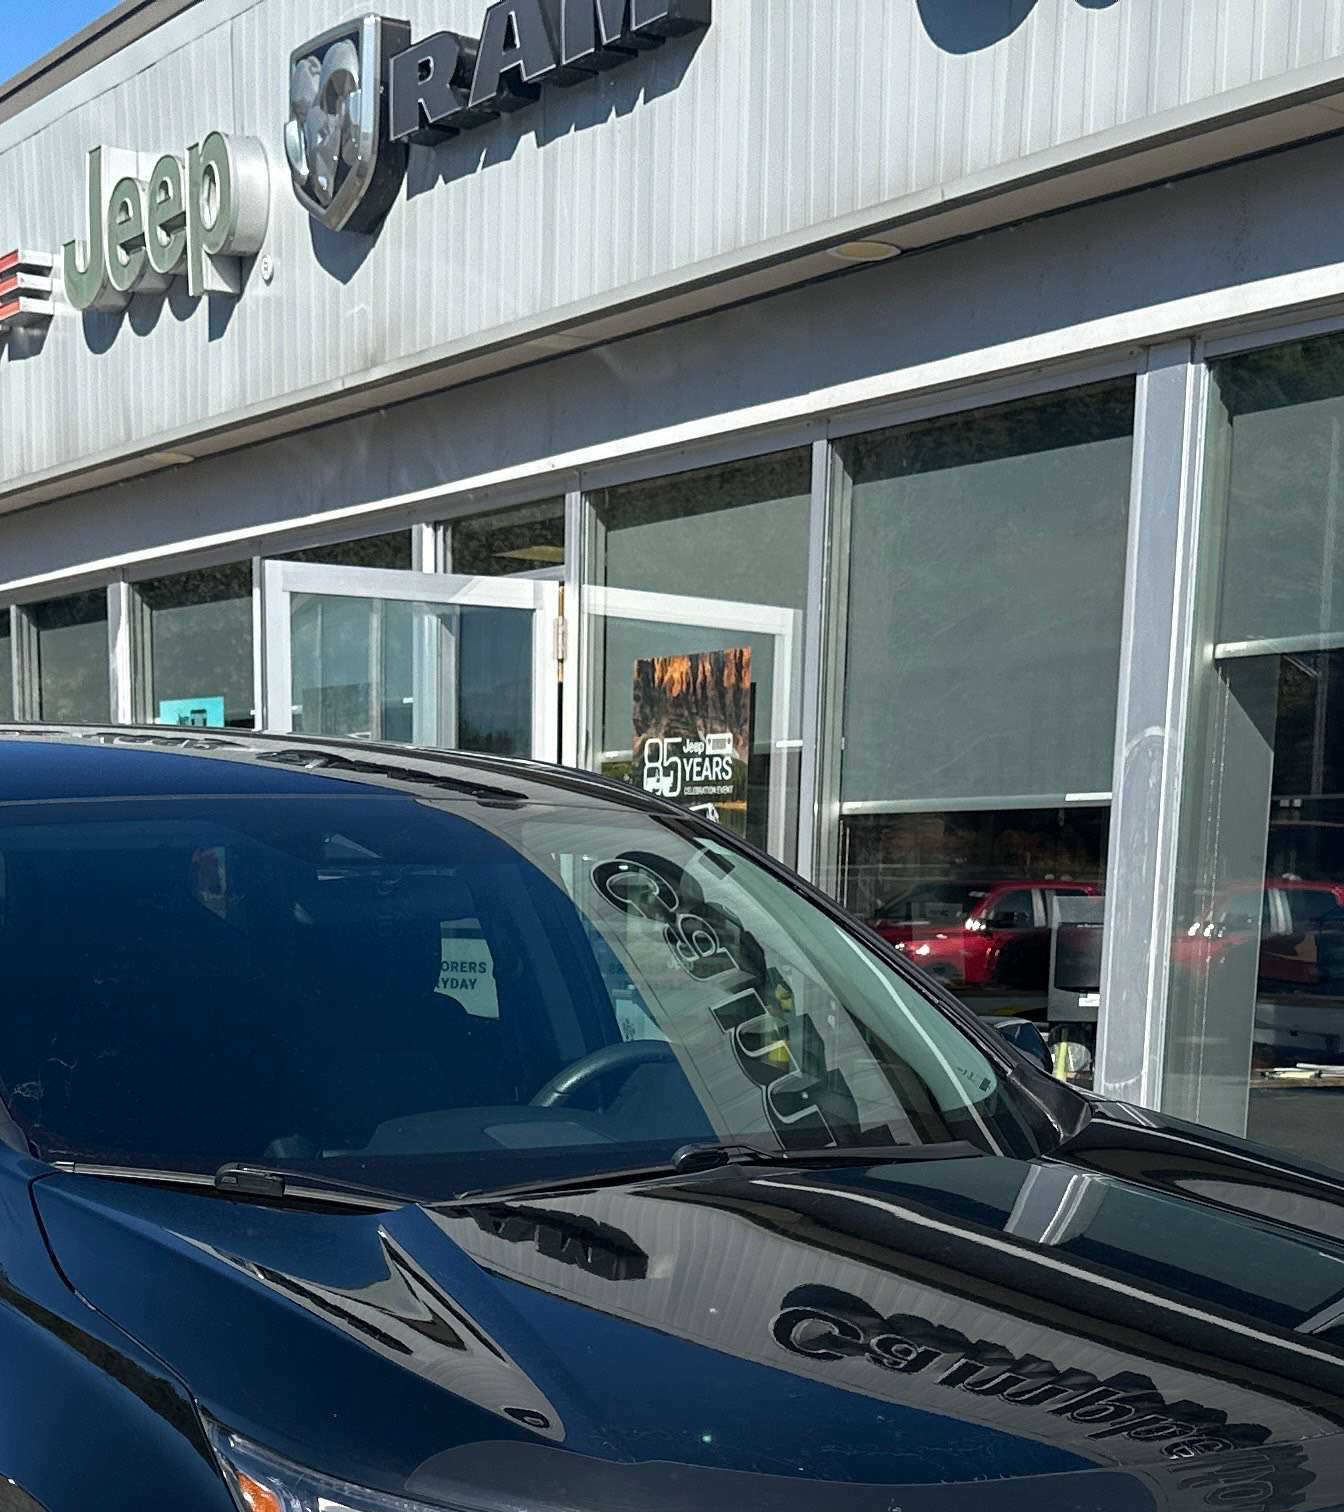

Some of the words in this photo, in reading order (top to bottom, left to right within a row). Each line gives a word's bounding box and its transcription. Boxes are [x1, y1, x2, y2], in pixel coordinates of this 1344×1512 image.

[59, 130, 234, 311] Jeep
[644, 737, 682, 797] 85
[682, 738, 705, 756] Jeep
[682, 756, 733, 782] YEARS
